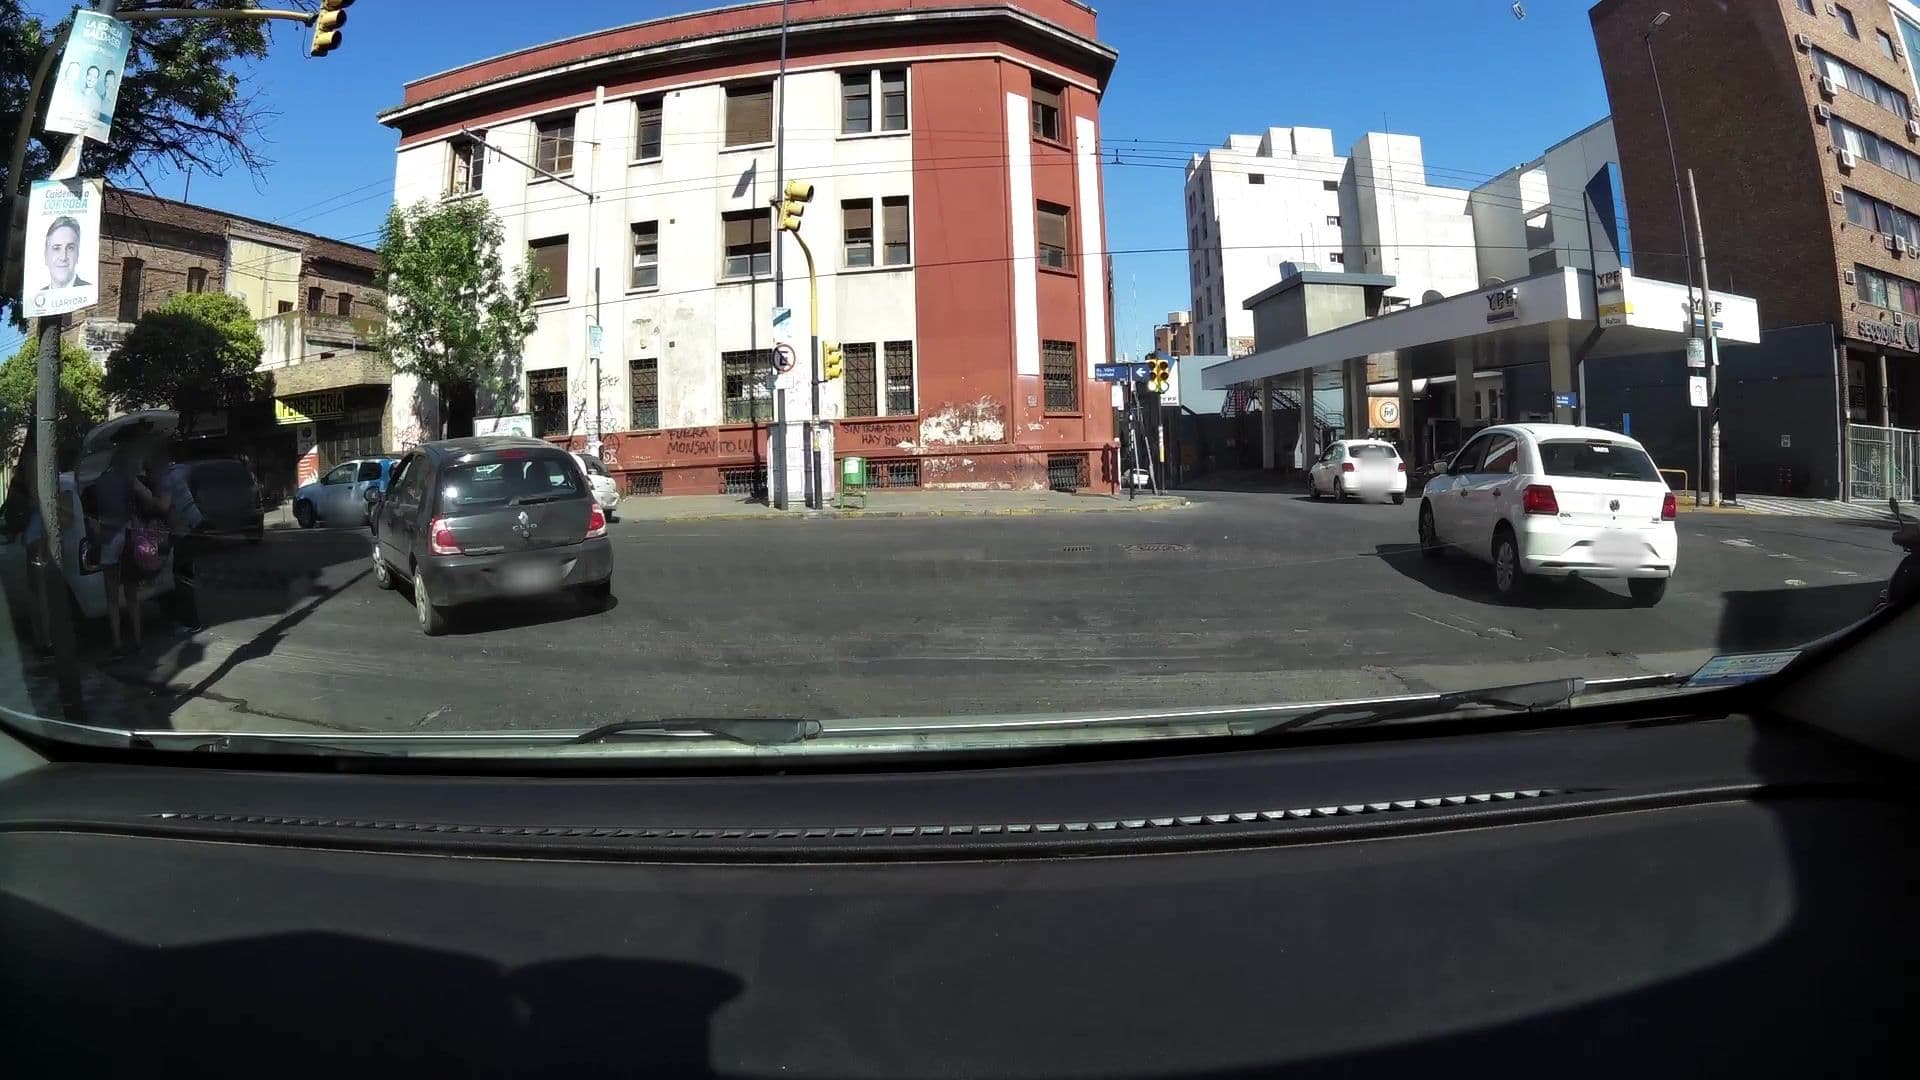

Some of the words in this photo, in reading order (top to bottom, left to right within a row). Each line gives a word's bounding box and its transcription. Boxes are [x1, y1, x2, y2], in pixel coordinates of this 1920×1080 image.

[1597, 270, 1622, 286] YPF
[1486, 288, 1518, 311] YPF
[1687, 295, 1723, 314] YF
[667, 427, 709, 440] FUERA
[843, 423, 861, 434] SIN
[897, 423, 911, 433] NO
[861, 434, 881, 445] HAY
